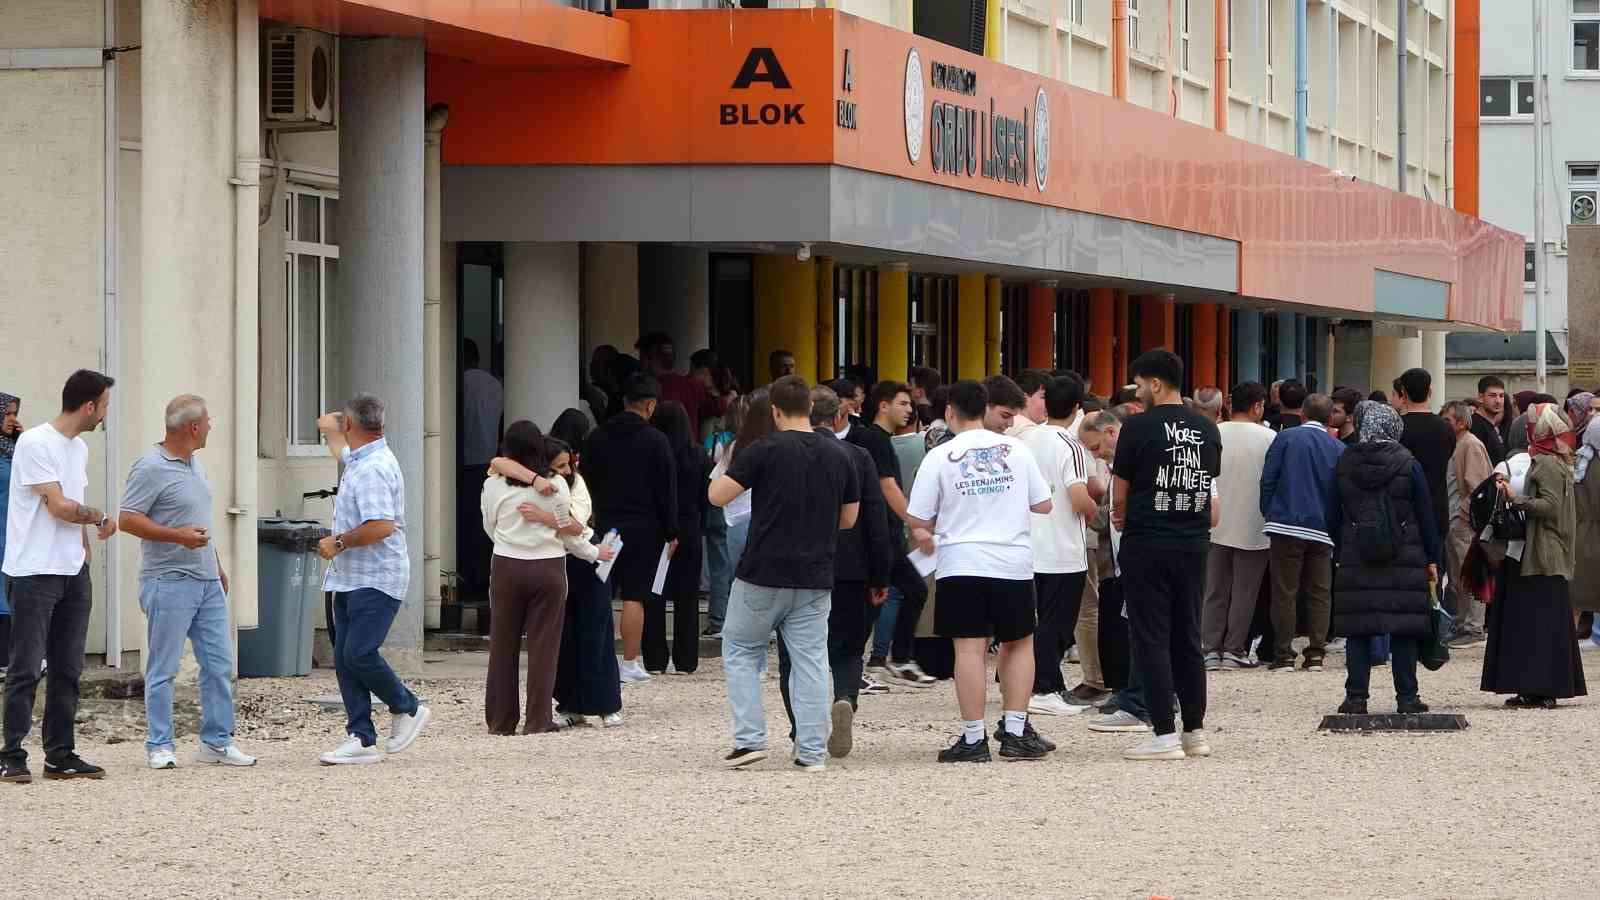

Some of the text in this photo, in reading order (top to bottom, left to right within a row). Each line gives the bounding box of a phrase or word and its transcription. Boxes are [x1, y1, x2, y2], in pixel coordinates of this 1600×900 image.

[731, 47, 793, 89] A
[842, 49, 852, 93] A
[720, 103, 806, 125] BLOK
[837, 99, 857, 130] BLOK
[931, 100, 977, 178] ORDU
[1165, 444, 1201, 469] THAN
[955, 475, 1015, 490] LES BENJAMINS
[1156, 465, 1211, 491] AN ATHLETE
